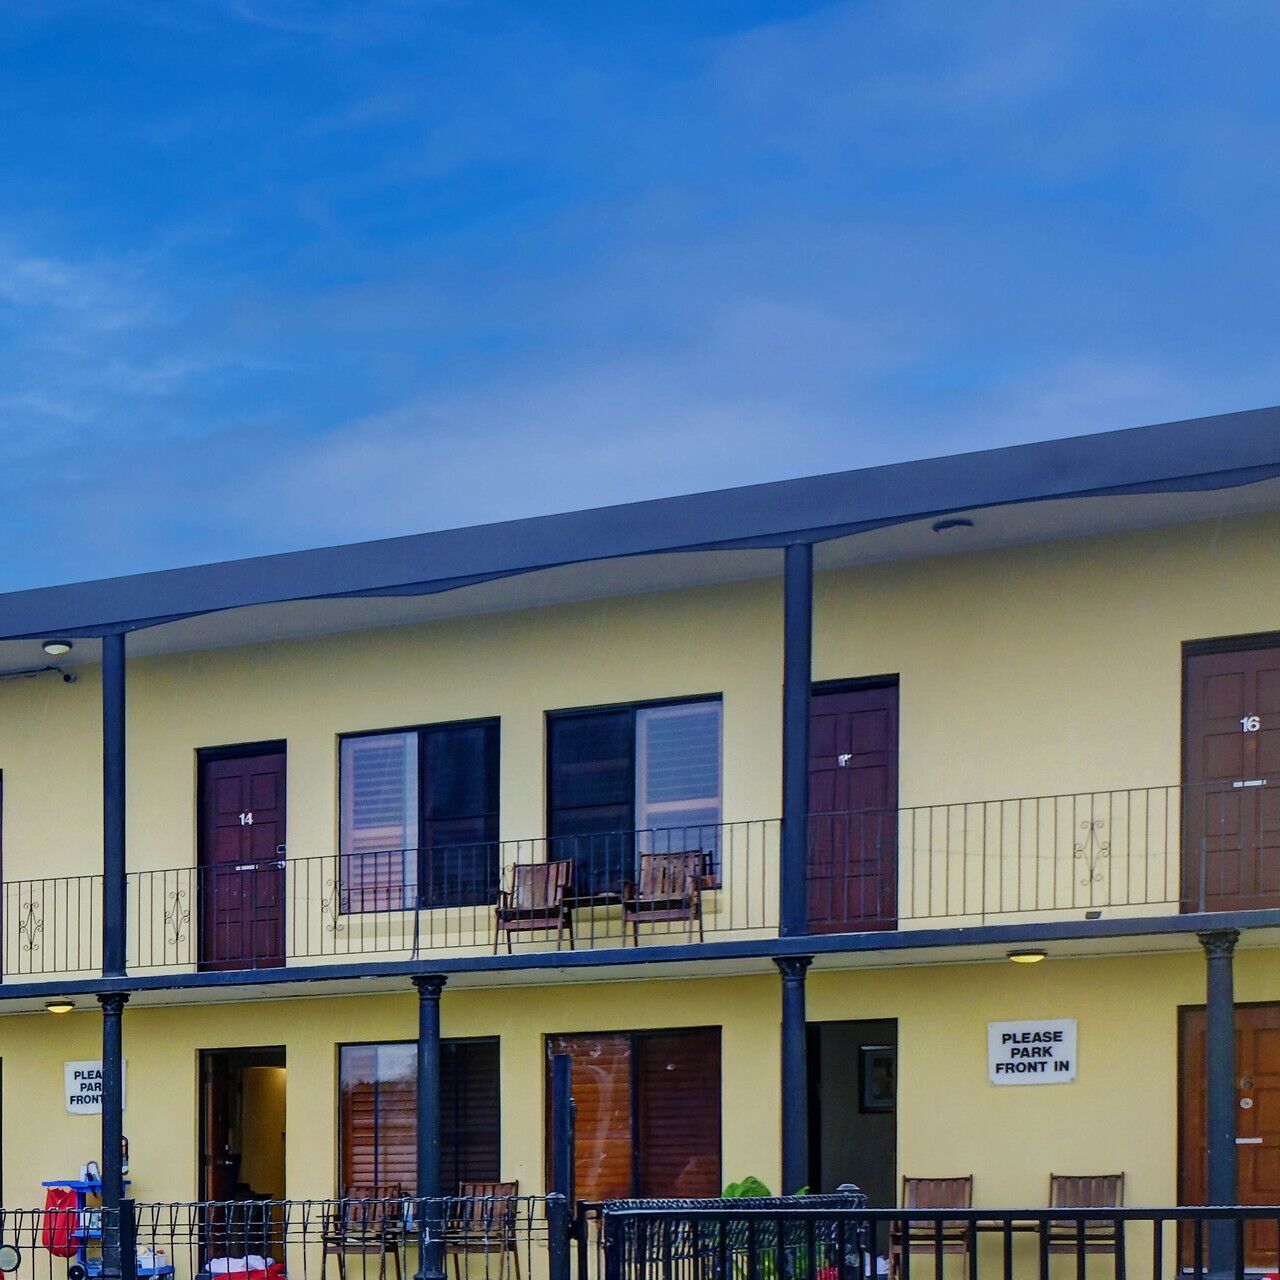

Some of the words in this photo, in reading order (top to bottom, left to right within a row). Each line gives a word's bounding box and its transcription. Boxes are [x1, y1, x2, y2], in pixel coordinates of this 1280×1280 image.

[1239, 715, 1261, 733] 16
[238, 812, 254, 826] 14
[1002, 1031, 1063, 1044] PLEASE
[1010, 1046, 1053, 1059] PARK
[995, 1061, 1048, 1074] FRONT
[1054, 1060, 1070, 1072] IN
[74, 1070, 103, 1080] PLEA
[80, 1082, 102, 1092] PAR
